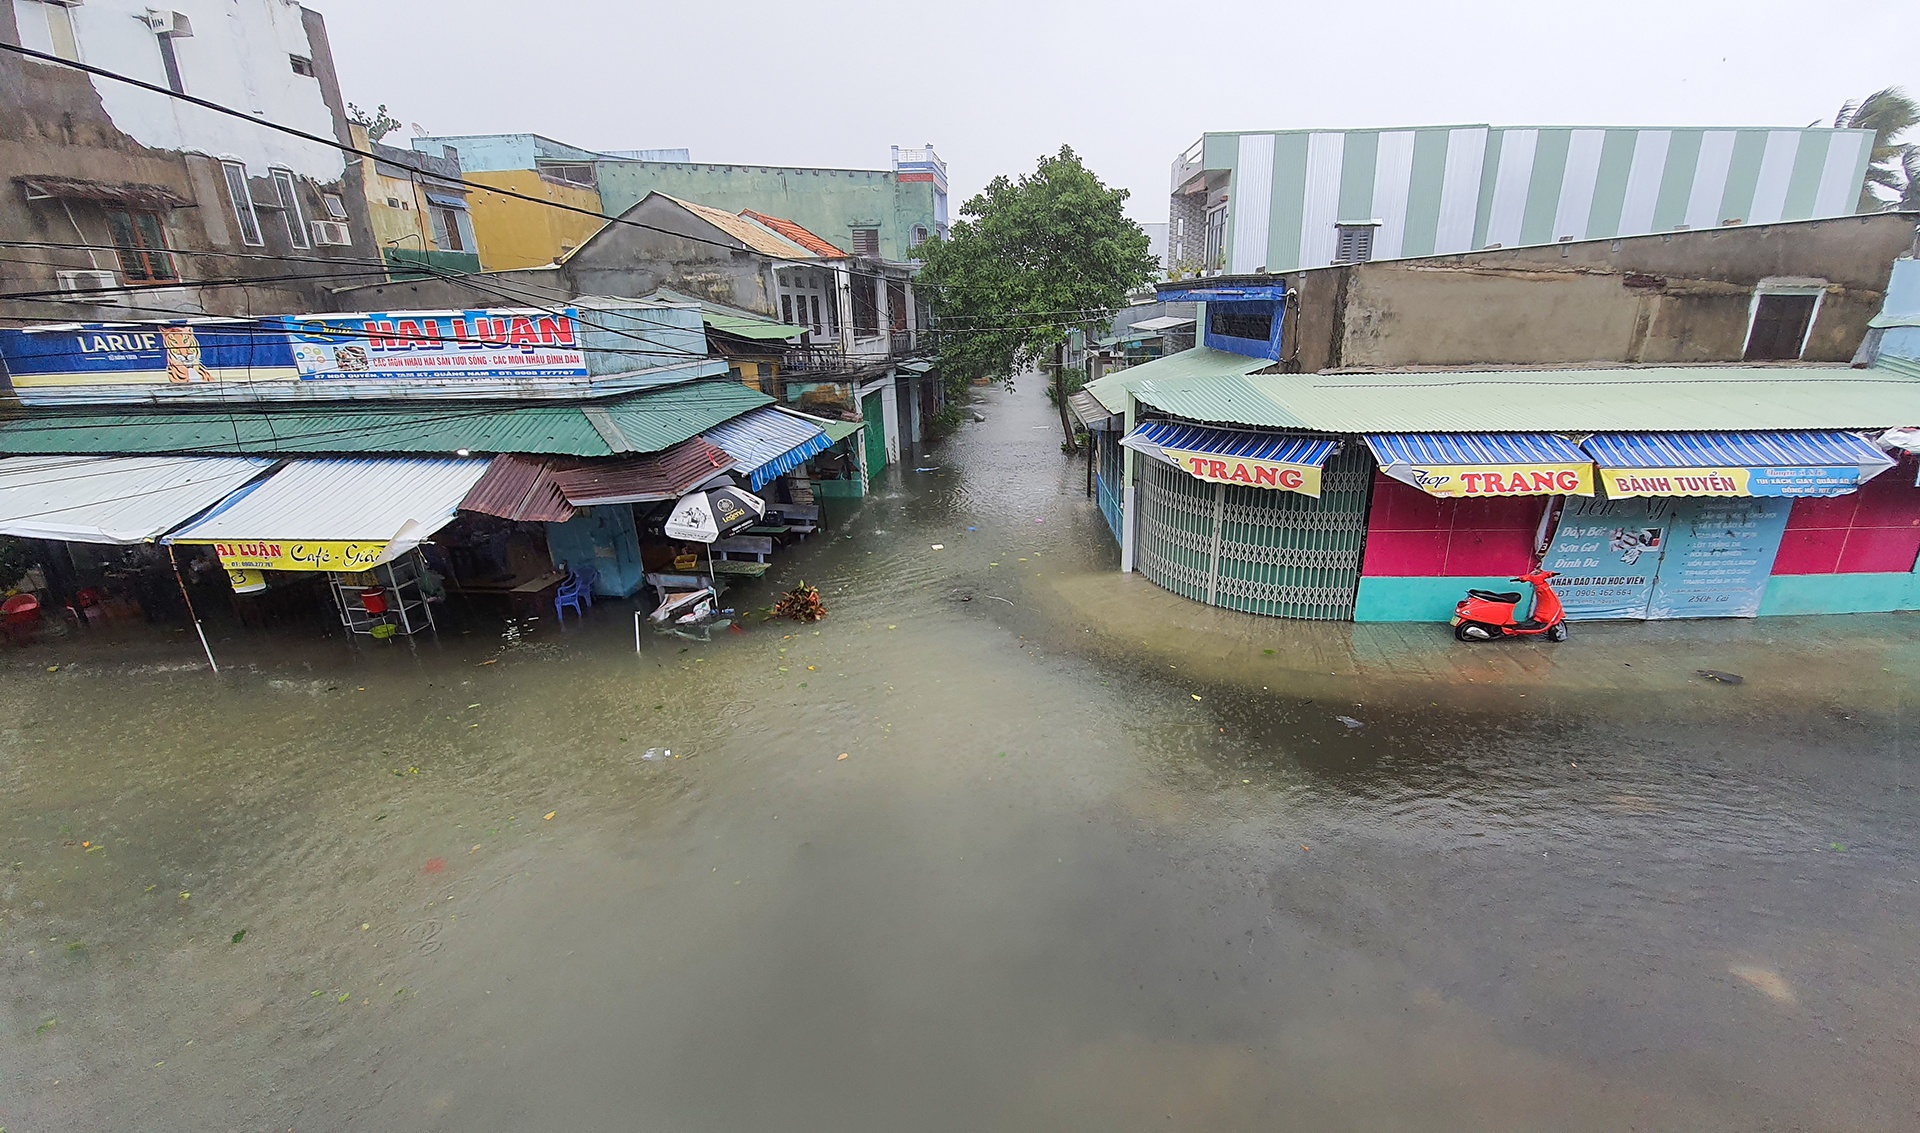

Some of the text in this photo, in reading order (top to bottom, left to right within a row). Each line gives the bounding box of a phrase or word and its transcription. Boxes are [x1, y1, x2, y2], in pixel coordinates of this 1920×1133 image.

[77, 333, 159, 353] LARUE
[363, 319, 443, 351] HAI
[1189, 457, 1303, 489] TRANG
[1460, 471, 1579, 493] TRANG
[1615, 471, 1737, 492] BÀNH TUYỂN
[238, 541, 281, 559] LUẬN
[291, 544, 331, 568] Café
